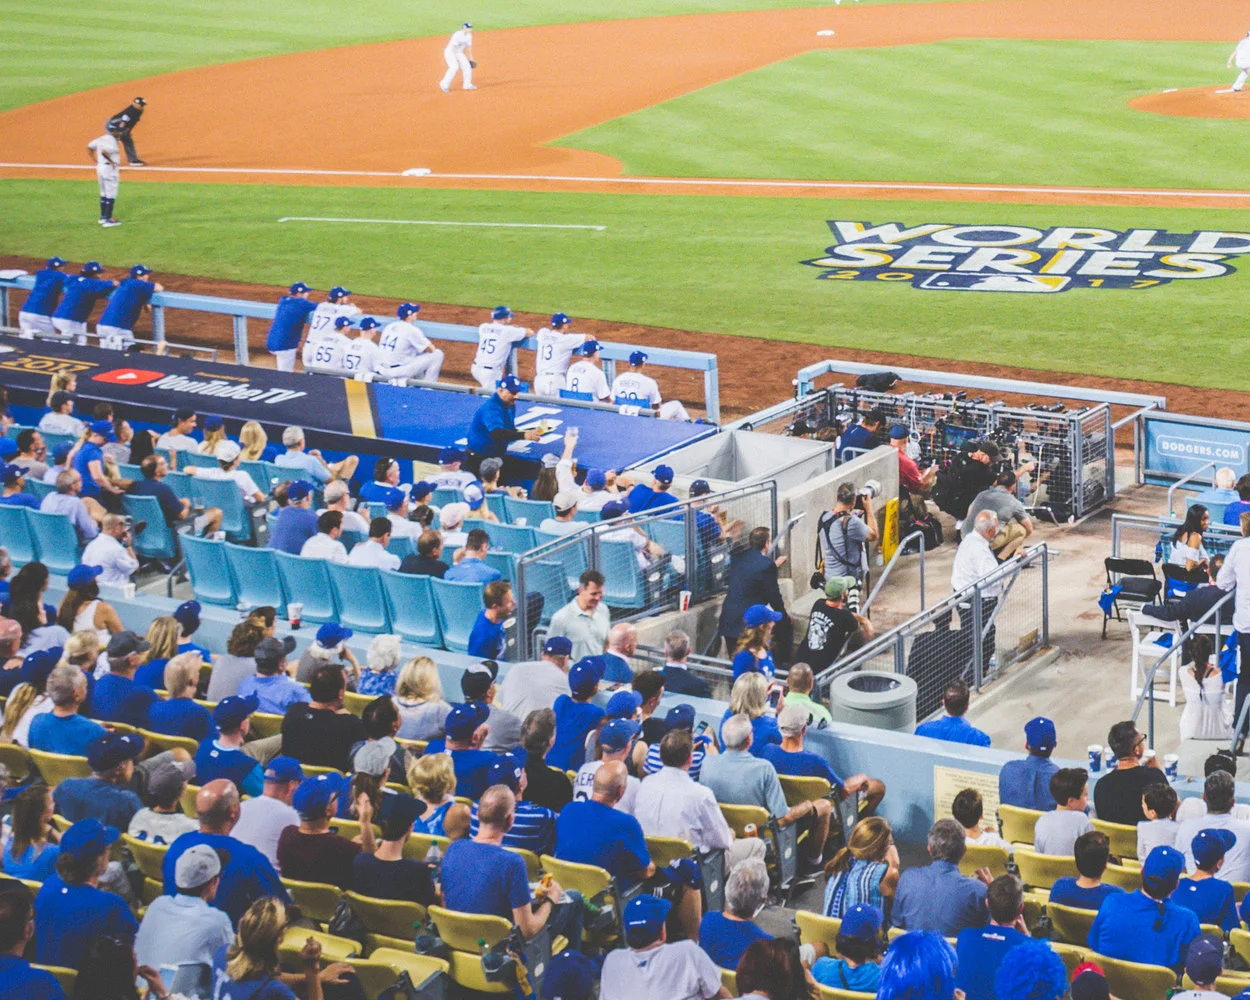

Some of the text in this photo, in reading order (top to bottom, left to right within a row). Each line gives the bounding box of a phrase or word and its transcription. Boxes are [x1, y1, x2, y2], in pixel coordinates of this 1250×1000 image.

[811, 243, 1228, 279] SERIES
[312, 315, 331, 330] 37
[381, 335, 399, 352] 44
[481, 338, 496, 354] 45
[541, 343, 553, 361] 13
[315, 346, 334, 363] 65
[346, 354, 362, 370] 57
[1161, 440, 1241, 460] DODGERS.COM
